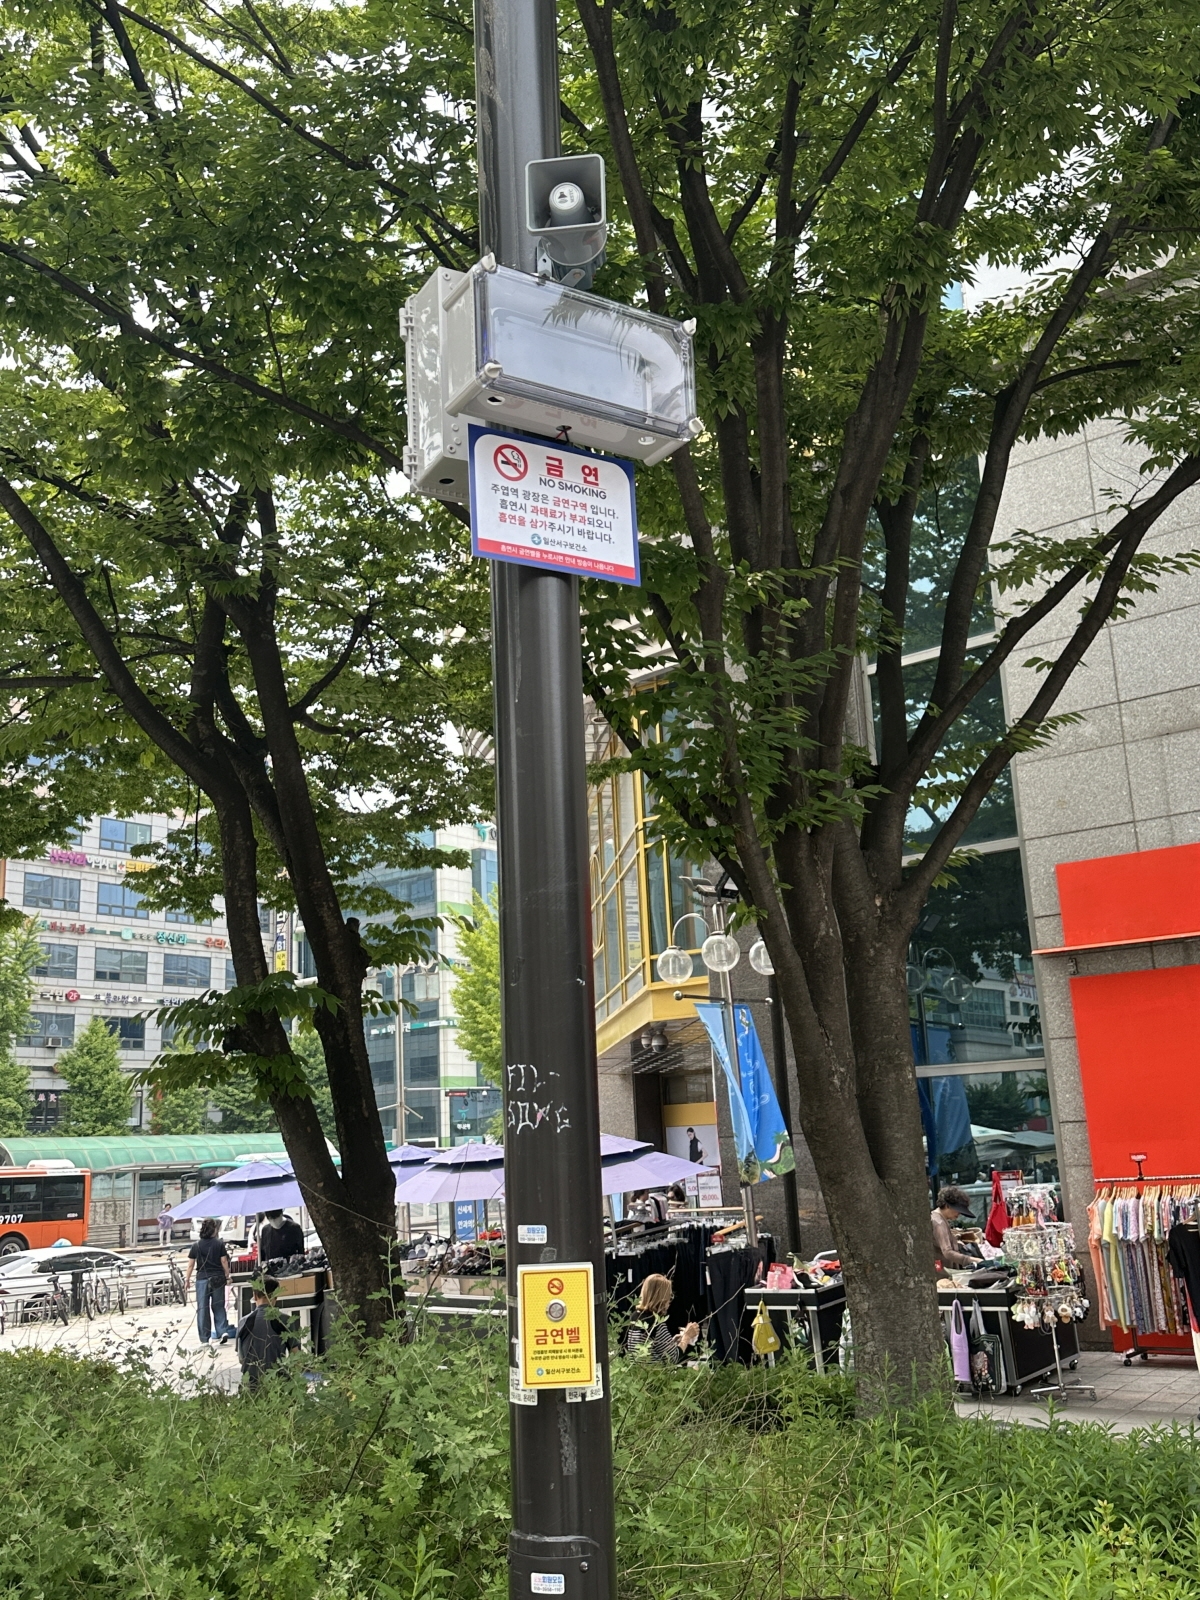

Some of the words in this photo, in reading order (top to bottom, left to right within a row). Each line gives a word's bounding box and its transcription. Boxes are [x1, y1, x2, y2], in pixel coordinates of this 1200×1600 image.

[546, 456, 564, 478] 금
[581, 465, 599, 486] 연
[539, 477, 556, 488] NO
[558, 481, 607, 500] SMOKING
[491, 483, 519, 499] 주엽역
[522, 490, 550, 505] 광장은
[552, 496, 588, 514] 금연구역
[590, 504, 619, 520] 입니다.
[499, 498, 528, 514] 흡연시
[530, 505, 567, 522] 과태료가
[569, 514, 613, 531] 부과되오니
[498, 511, 527, 527] 흡연을
[529, 518, 575, 537] 삼가주시기
[577, 528, 615, 544] 바랍니다.
[542, 537, 588, 553] 일산서구보건소
[157, 930, 188, 946] 정신과
[68, 990, 79, 1000] 2F
[534, 1326, 581, 1346] 금연벨
[545, 1367, 581, 1375] 일산서구보건소
